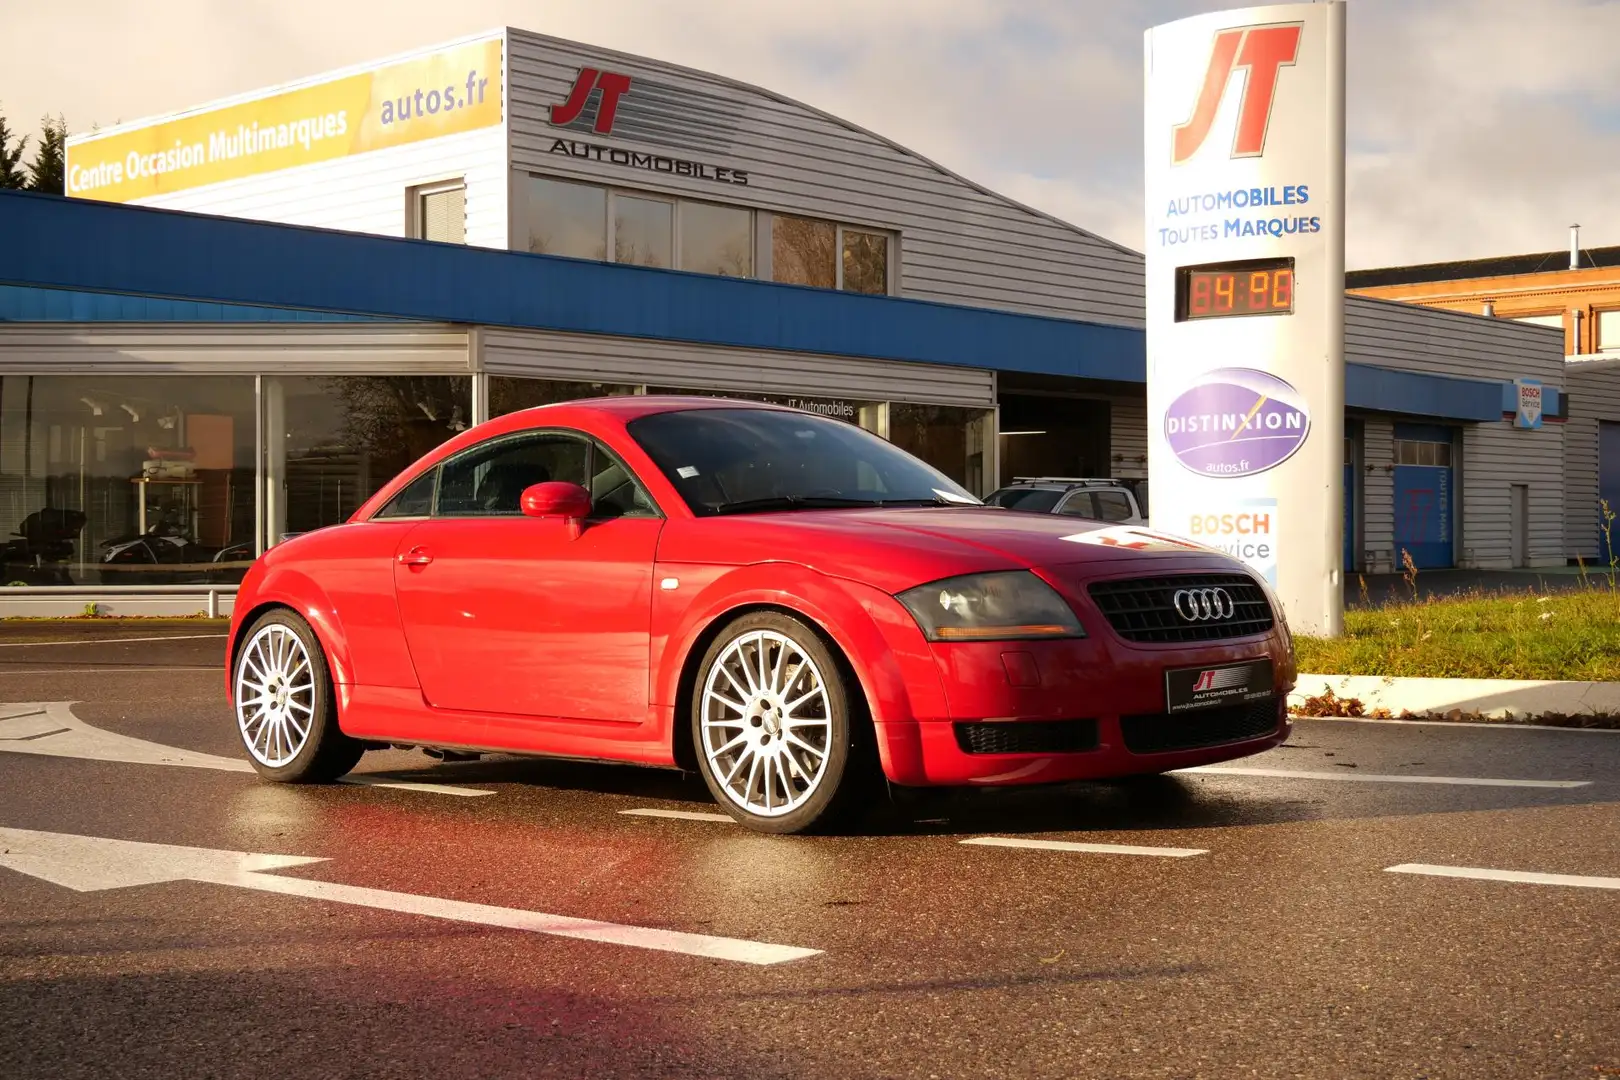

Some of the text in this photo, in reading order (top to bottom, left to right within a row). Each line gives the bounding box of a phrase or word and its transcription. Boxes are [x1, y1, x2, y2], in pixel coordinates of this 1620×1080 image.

[381, 70, 488, 125] autos.fr
[550, 66, 632, 136] JT
[1171, 22, 1304, 166] JT
[69, 110, 347, 192] Centre Occasion Multimarques
[549, 138, 750, 186] AUTOMOBILES
[1166, 184, 1309, 218] AUTOMOBILES
[1521, 387, 1540, 398] BOSCH
[1521, 397, 1540, 409] Service
[799, 399, 854, 417] Automobiles
[1167, 410, 1301, 435] DISTINXION
[1205, 459, 1250, 473] autos.fr
[1190, 513, 1269, 534] BOSCH
[1193, 670, 1216, 692] JT
[1193, 687, 1248, 699] AUTOMOBILES
